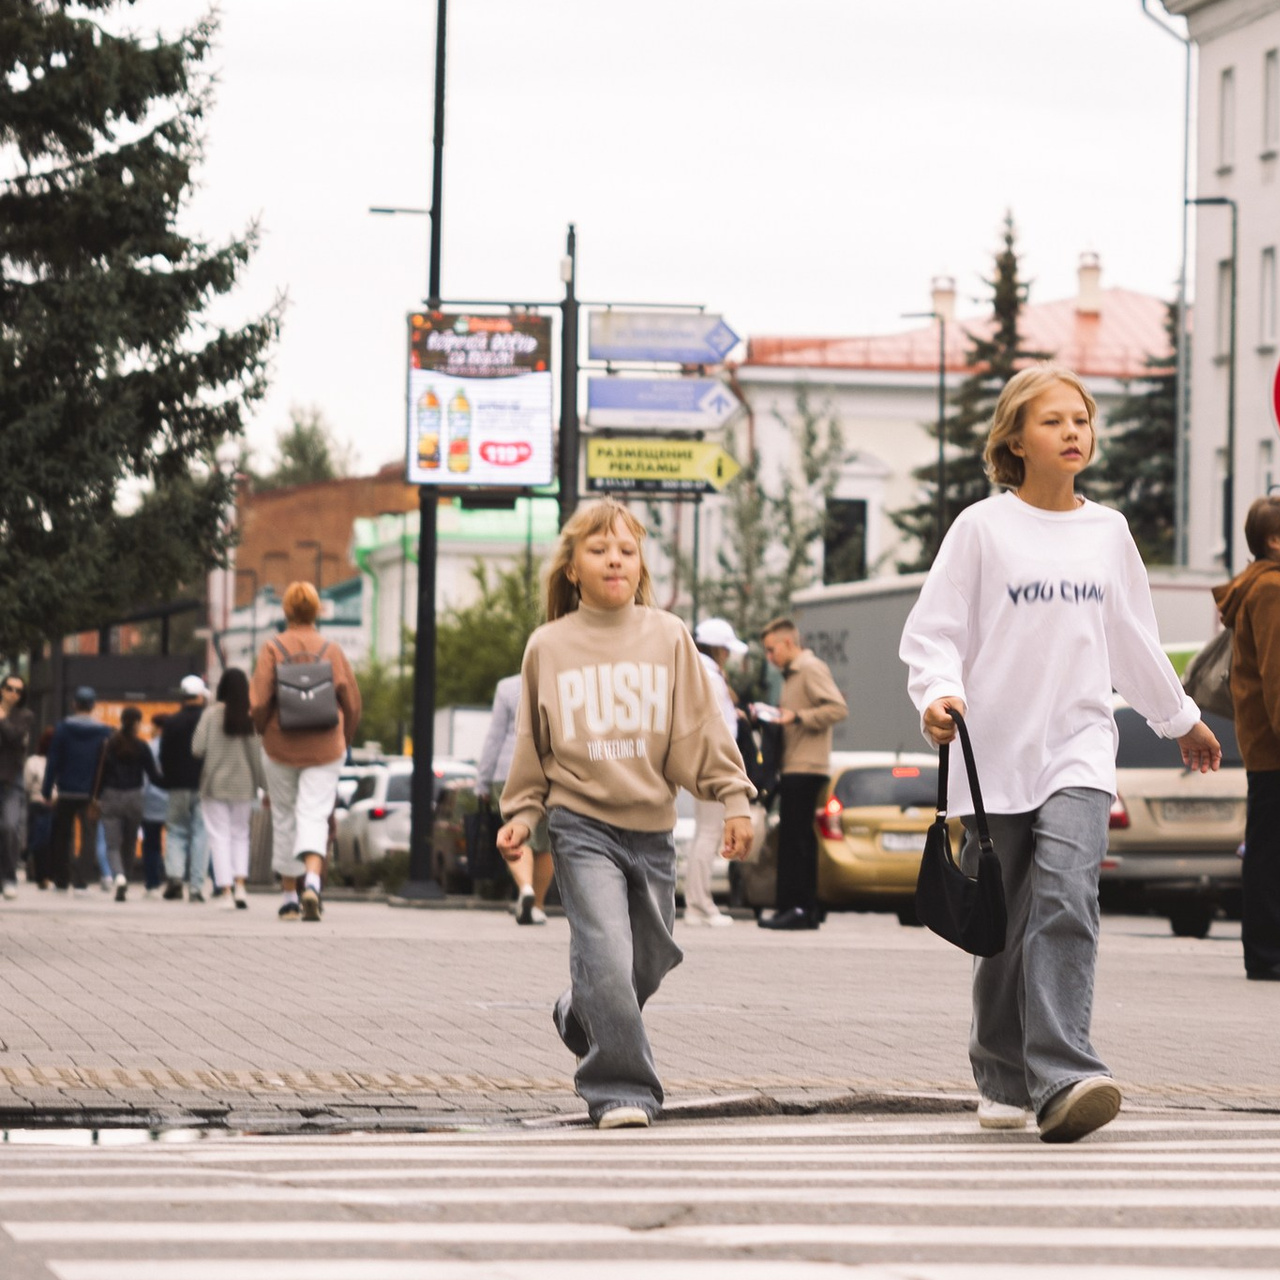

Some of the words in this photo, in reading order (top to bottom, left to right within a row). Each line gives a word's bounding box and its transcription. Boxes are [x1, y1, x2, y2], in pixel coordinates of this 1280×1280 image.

[597, 447, 693, 460] РАЗМЕЩЕНИЕ
[609, 461, 681, 473] РЕКЛАМЫ
[1007, 578, 1054, 605] YOU
[557, 661, 669, 742] PUSH
[586, 740, 603, 762] THE
[603, 738, 635, 760] FEELING
